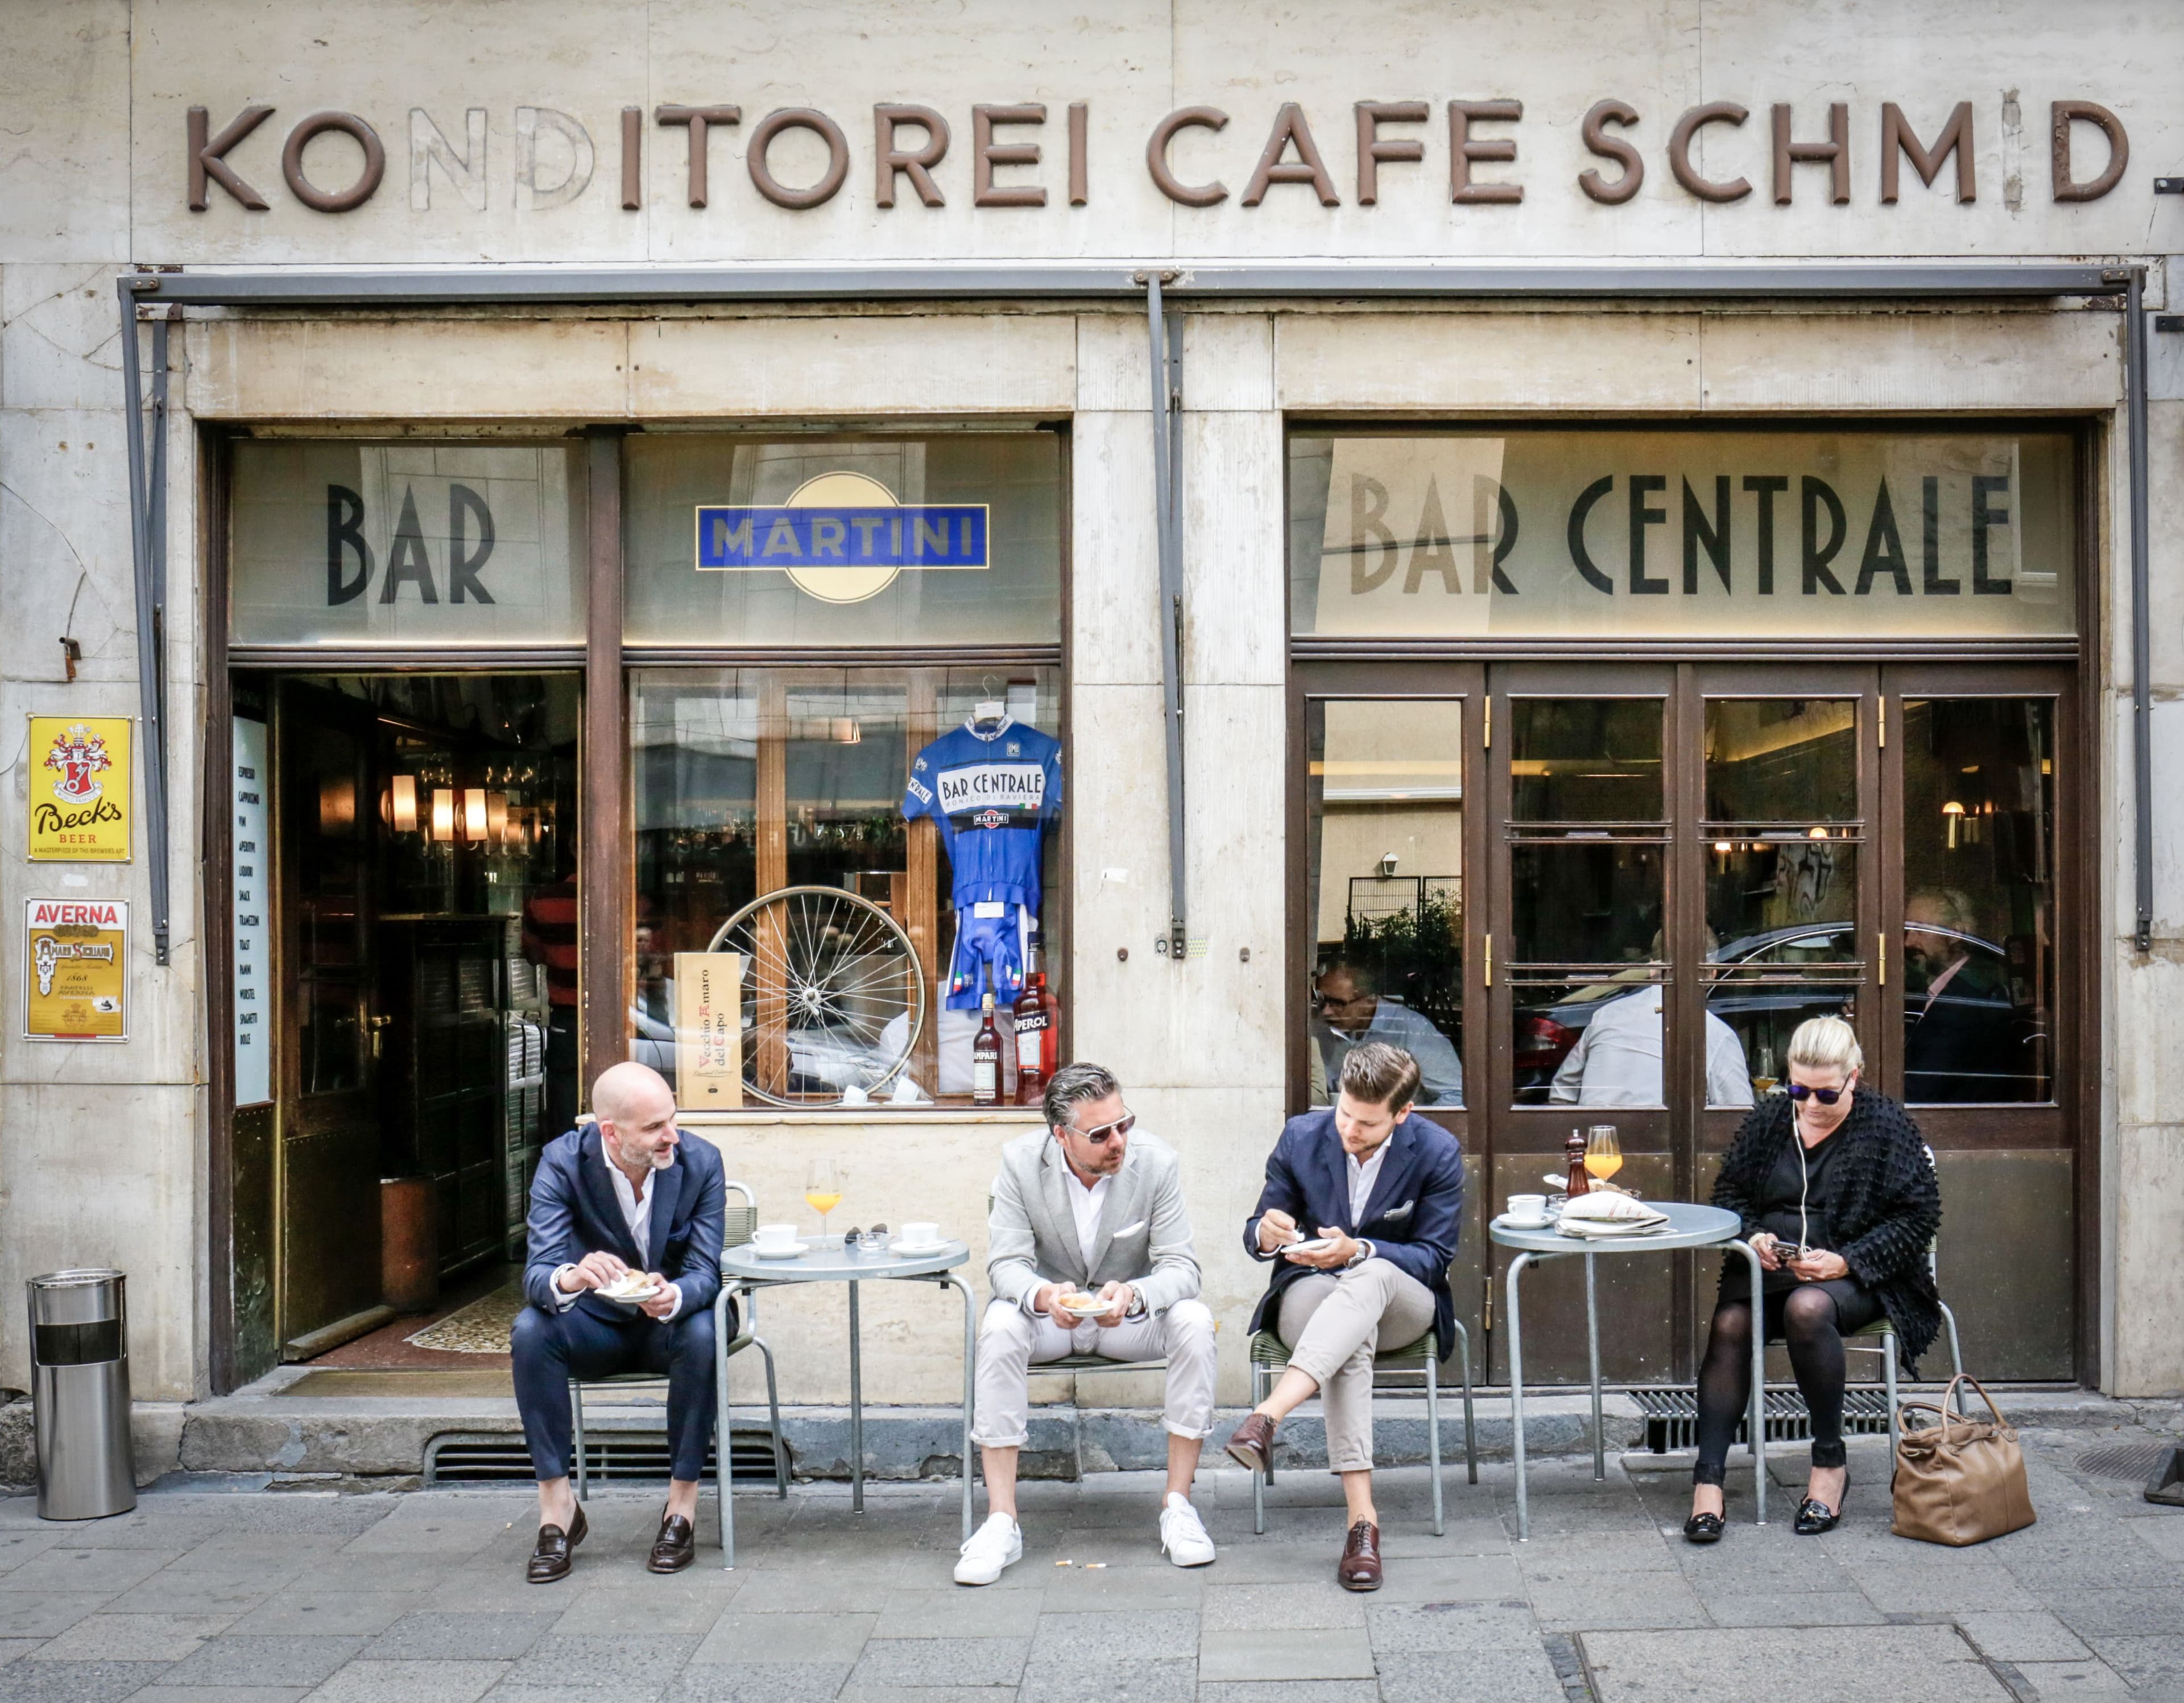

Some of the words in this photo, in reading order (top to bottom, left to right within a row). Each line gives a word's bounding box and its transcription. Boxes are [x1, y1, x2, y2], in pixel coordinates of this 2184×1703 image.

[187, 104, 1089, 213] KONDITOREI
[1145, 99, 1525, 208] CAFE
[1577, 97, 2130, 206] SCHMID
[328, 482, 496, 606] BAR
[713, 516, 972, 557] MARTINI
[1350, 472, 1519, 596] BAR
[1567, 472, 2013, 597] CENTRALE
[942, 778, 968, 800] BAR
[973, 774, 1041, 793] CENTRALE
[35, 796, 122, 834] Beck's
[975, 814, 1008, 823] MARTINI
[59, 834, 97, 843] BEER
[34, 904, 118, 924] AVERNA
[239, 939, 250, 950] TOAST
[699, 969, 710, 1018] Amaro
[239, 1033, 251, 1045] DOLCE
[713, 1012, 727, 1047] Capo
[1014, 1016, 1048, 1032] APEROL
[699, 1019, 712, 1068] Vecchio
[714, 1048, 725, 1067] del
